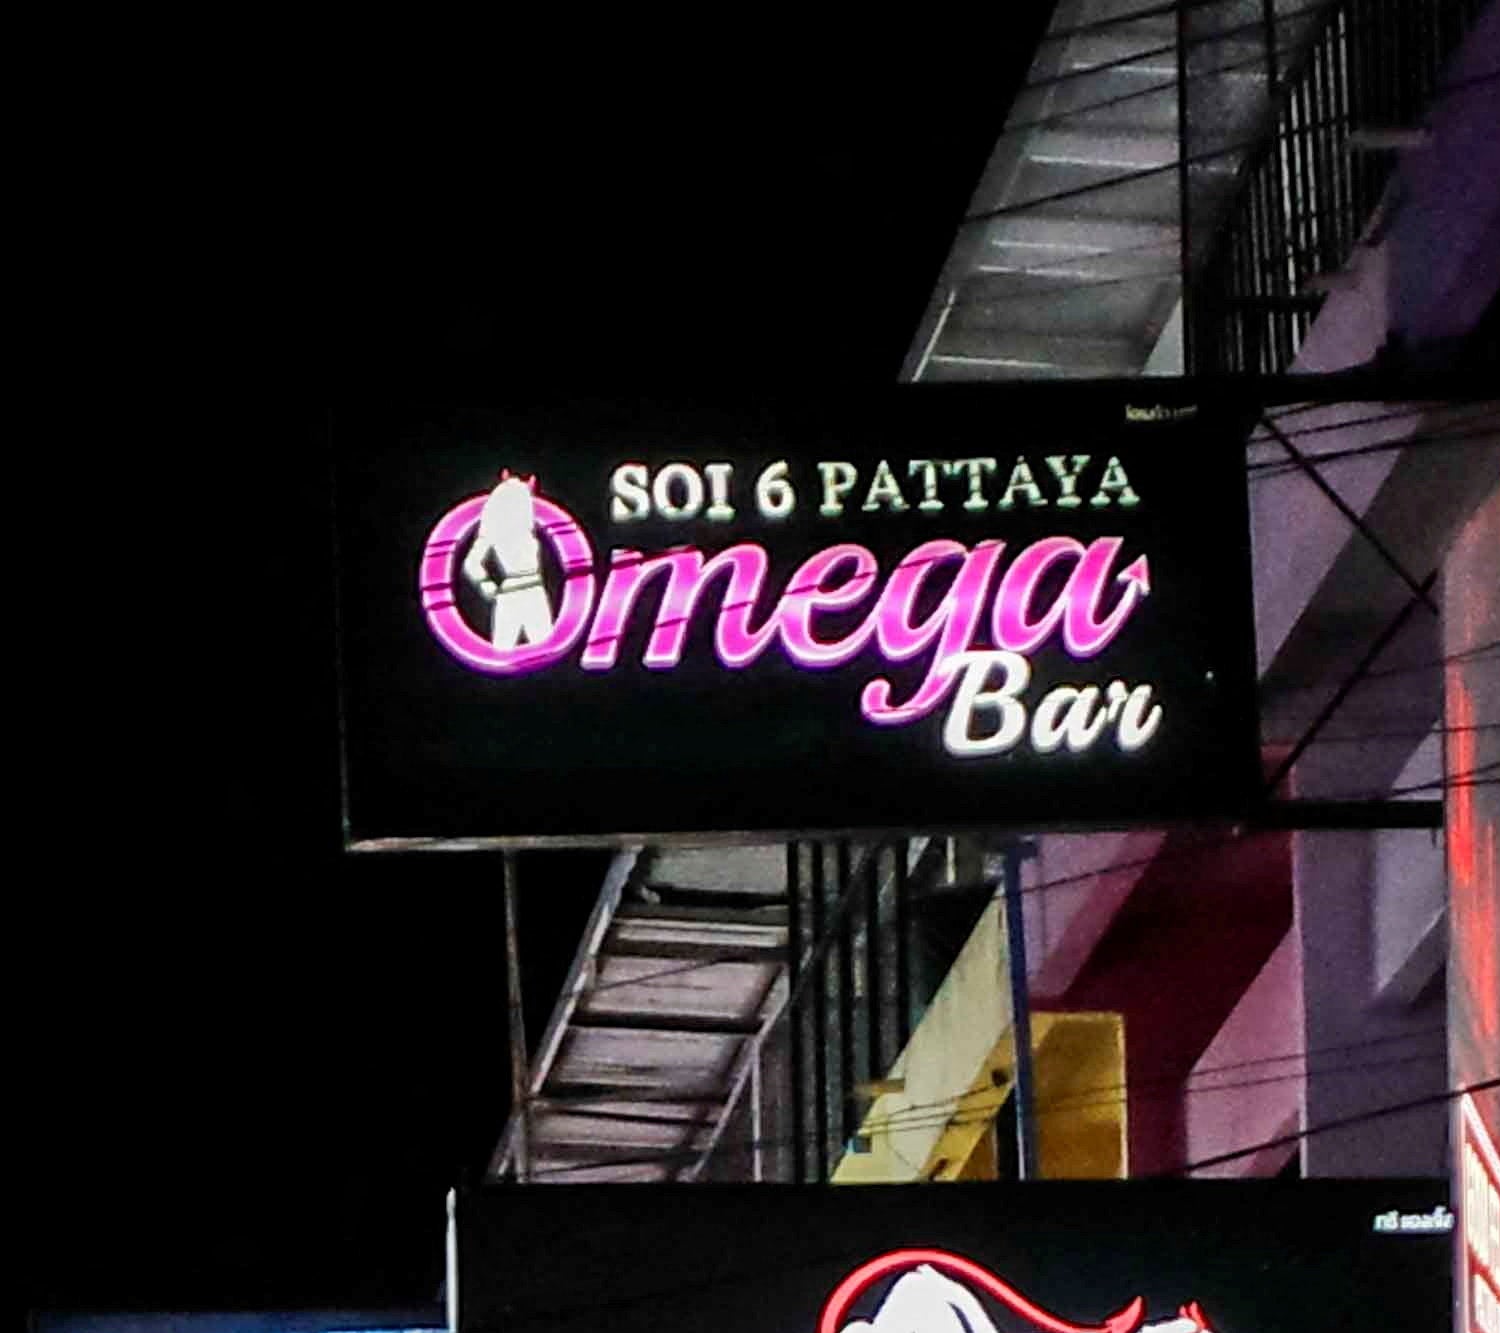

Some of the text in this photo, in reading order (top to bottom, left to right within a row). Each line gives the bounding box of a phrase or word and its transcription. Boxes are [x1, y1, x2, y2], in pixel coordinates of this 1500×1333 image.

[610, 455, 1141, 521] SOI 6 PATTAYA
[421, 475, 1150, 724] Omega
[942, 649, 1164, 759] Bar
